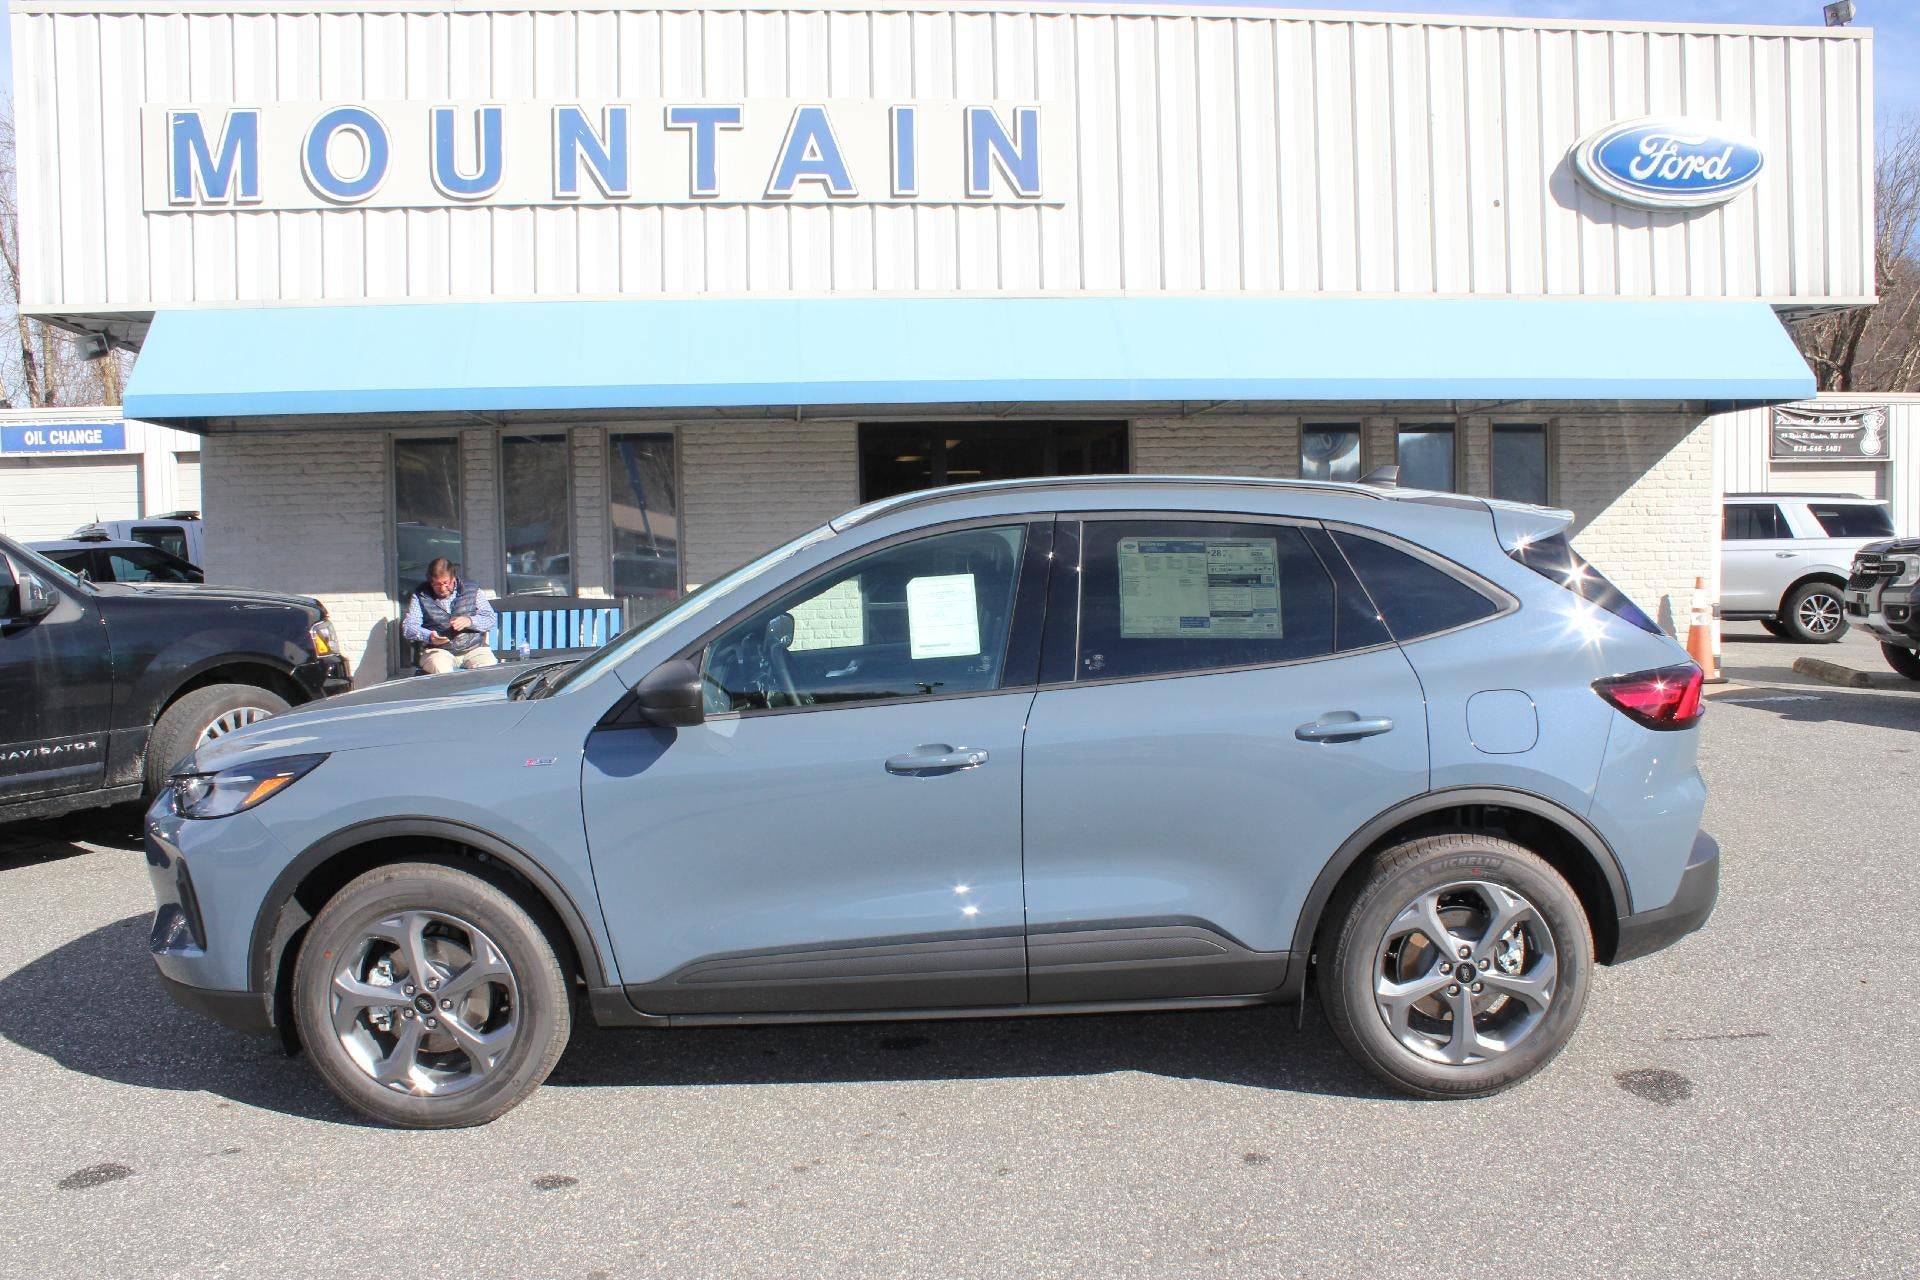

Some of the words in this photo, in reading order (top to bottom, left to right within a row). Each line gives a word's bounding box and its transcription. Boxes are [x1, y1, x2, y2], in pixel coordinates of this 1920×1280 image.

[168, 104, 1043, 205] MOUNTAIN
[1629, 134, 1733, 181] Ford
[24, 431, 46, 446] OIL
[49, 429, 103, 445] CHANGE
[1431, 856, 1502, 872] MICHELIN
